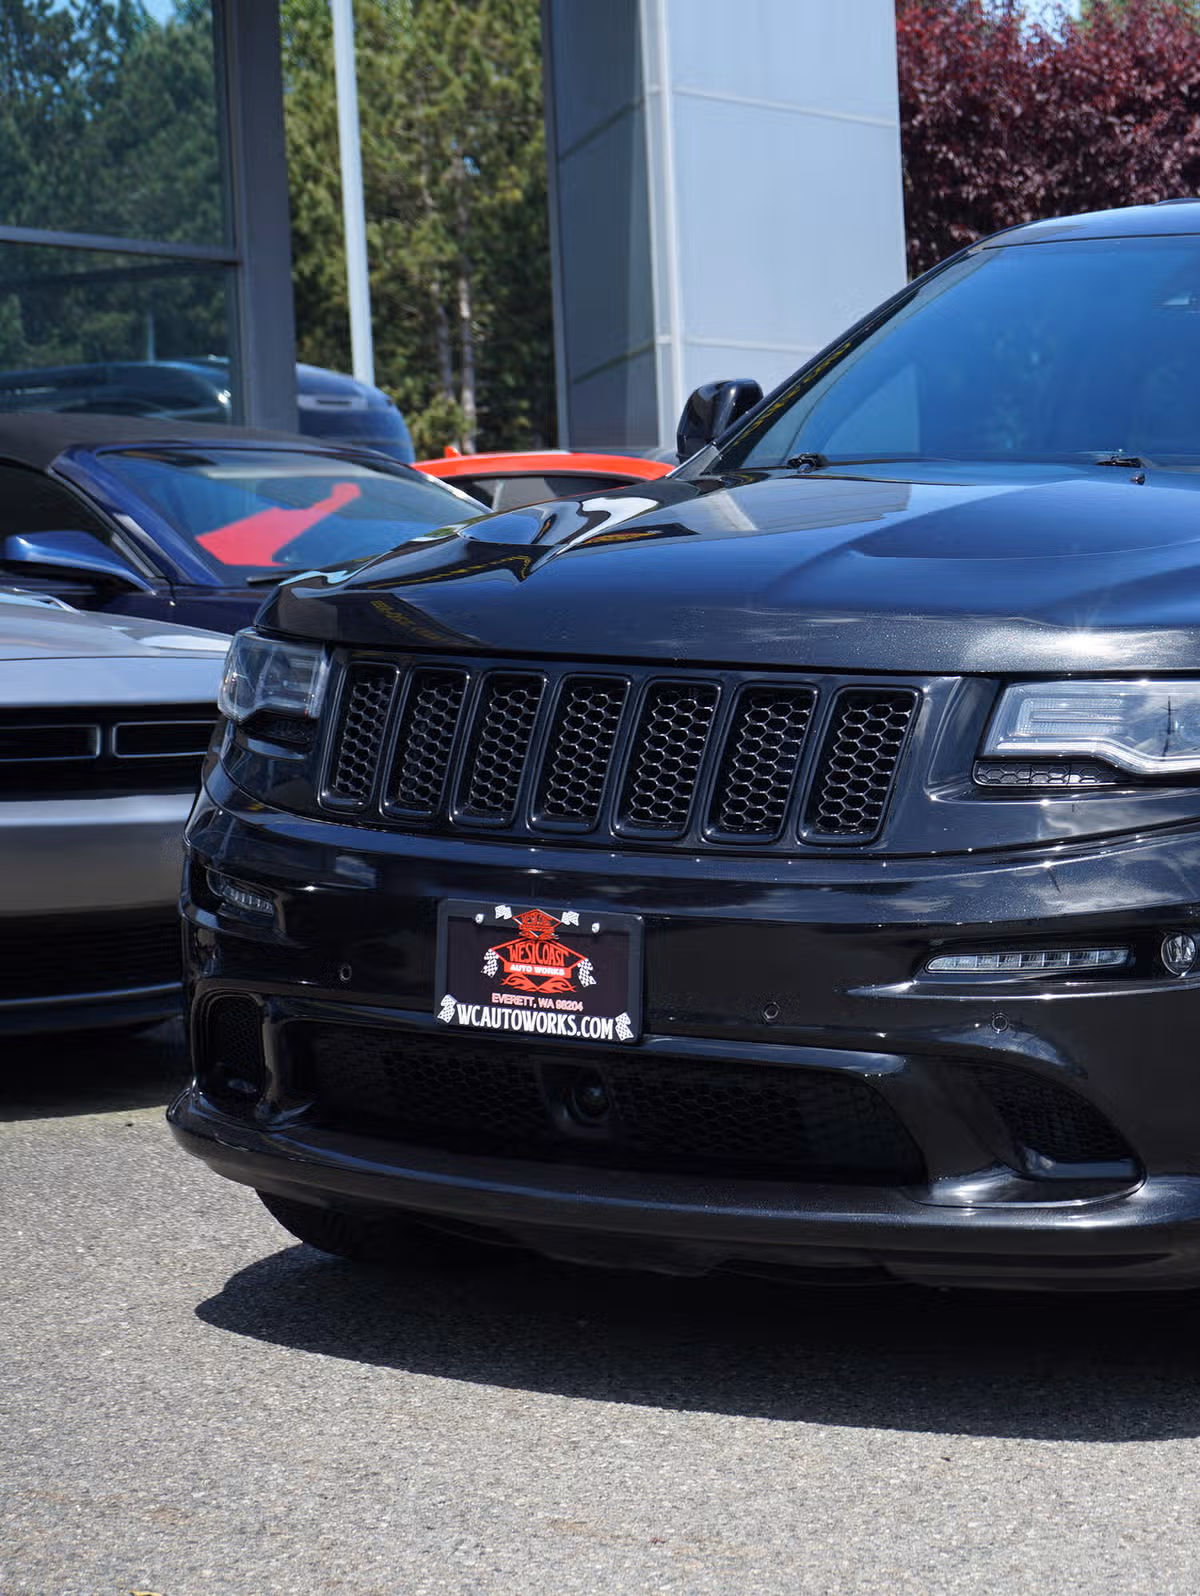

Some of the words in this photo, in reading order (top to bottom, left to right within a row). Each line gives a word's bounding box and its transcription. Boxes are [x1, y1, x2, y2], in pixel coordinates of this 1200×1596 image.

[510, 964, 533, 973] AUTO
[534, 966, 566, 977] WORKS
[491, 993, 537, 1008] EVERETT,
[538, 997, 555, 1010] WA
[456, 1004, 614, 1040] WCAUTOWORKS.COM
